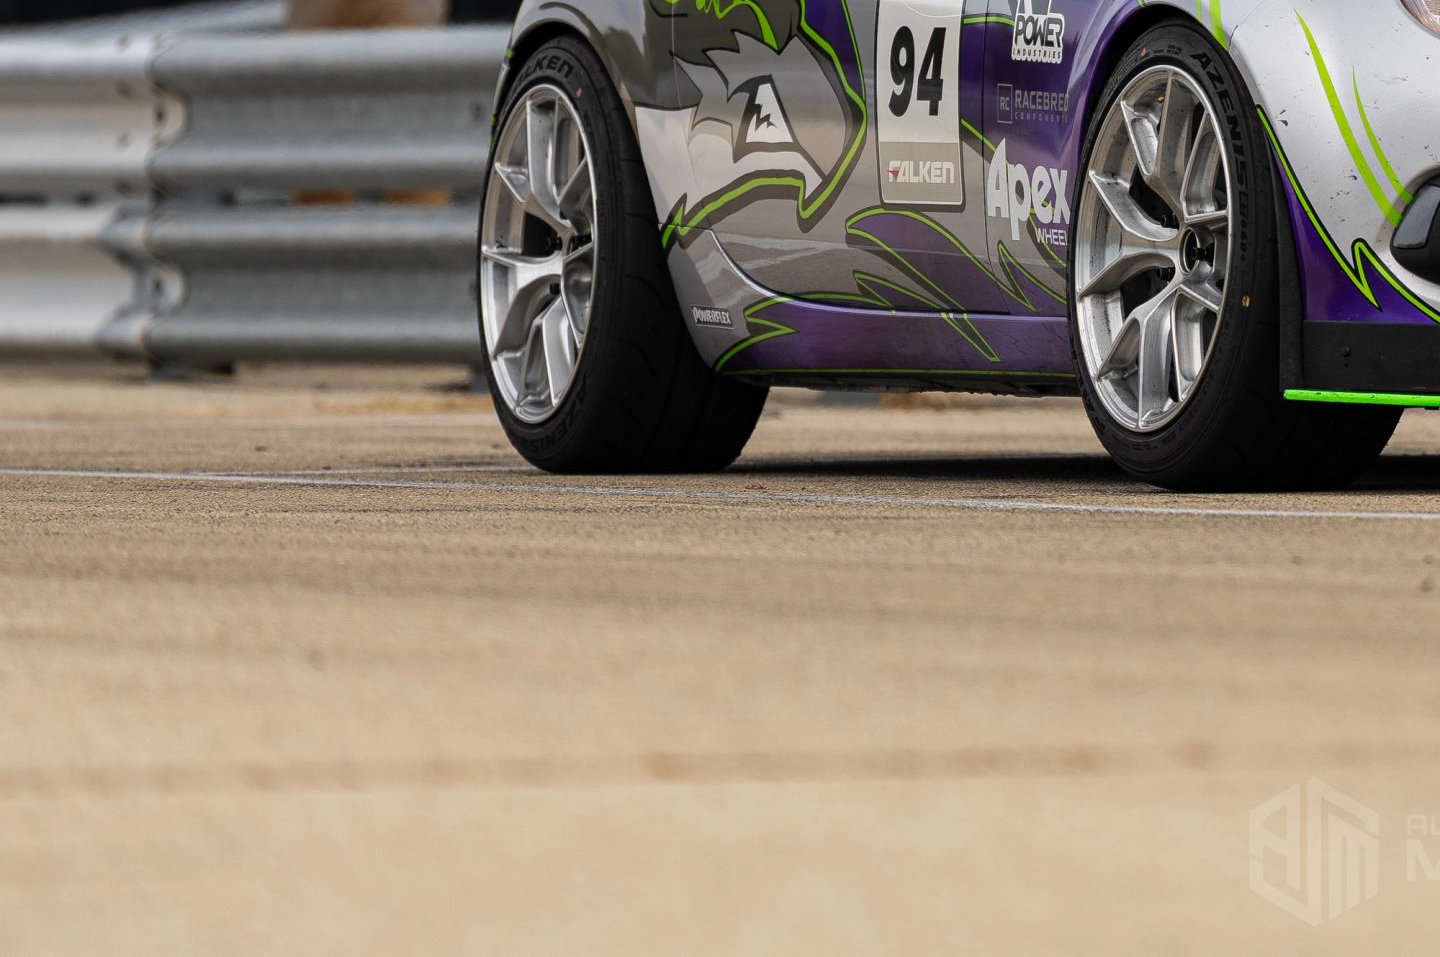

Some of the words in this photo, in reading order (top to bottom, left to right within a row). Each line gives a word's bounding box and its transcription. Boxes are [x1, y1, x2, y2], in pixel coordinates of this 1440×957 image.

[1014, 14, 1063, 48] POWER
[1012, 47, 1062, 59] INDUSTRIES
[888, 25, 947, 118] 94
[1014, 89, 1069, 112] RACEBRED
[1190, 50, 1249, 189] AZENIS
[887, 160, 955, 184] FALKEN
[987, 137, 1071, 241] Apex
[692, 306, 732, 325] POWERFLEX
